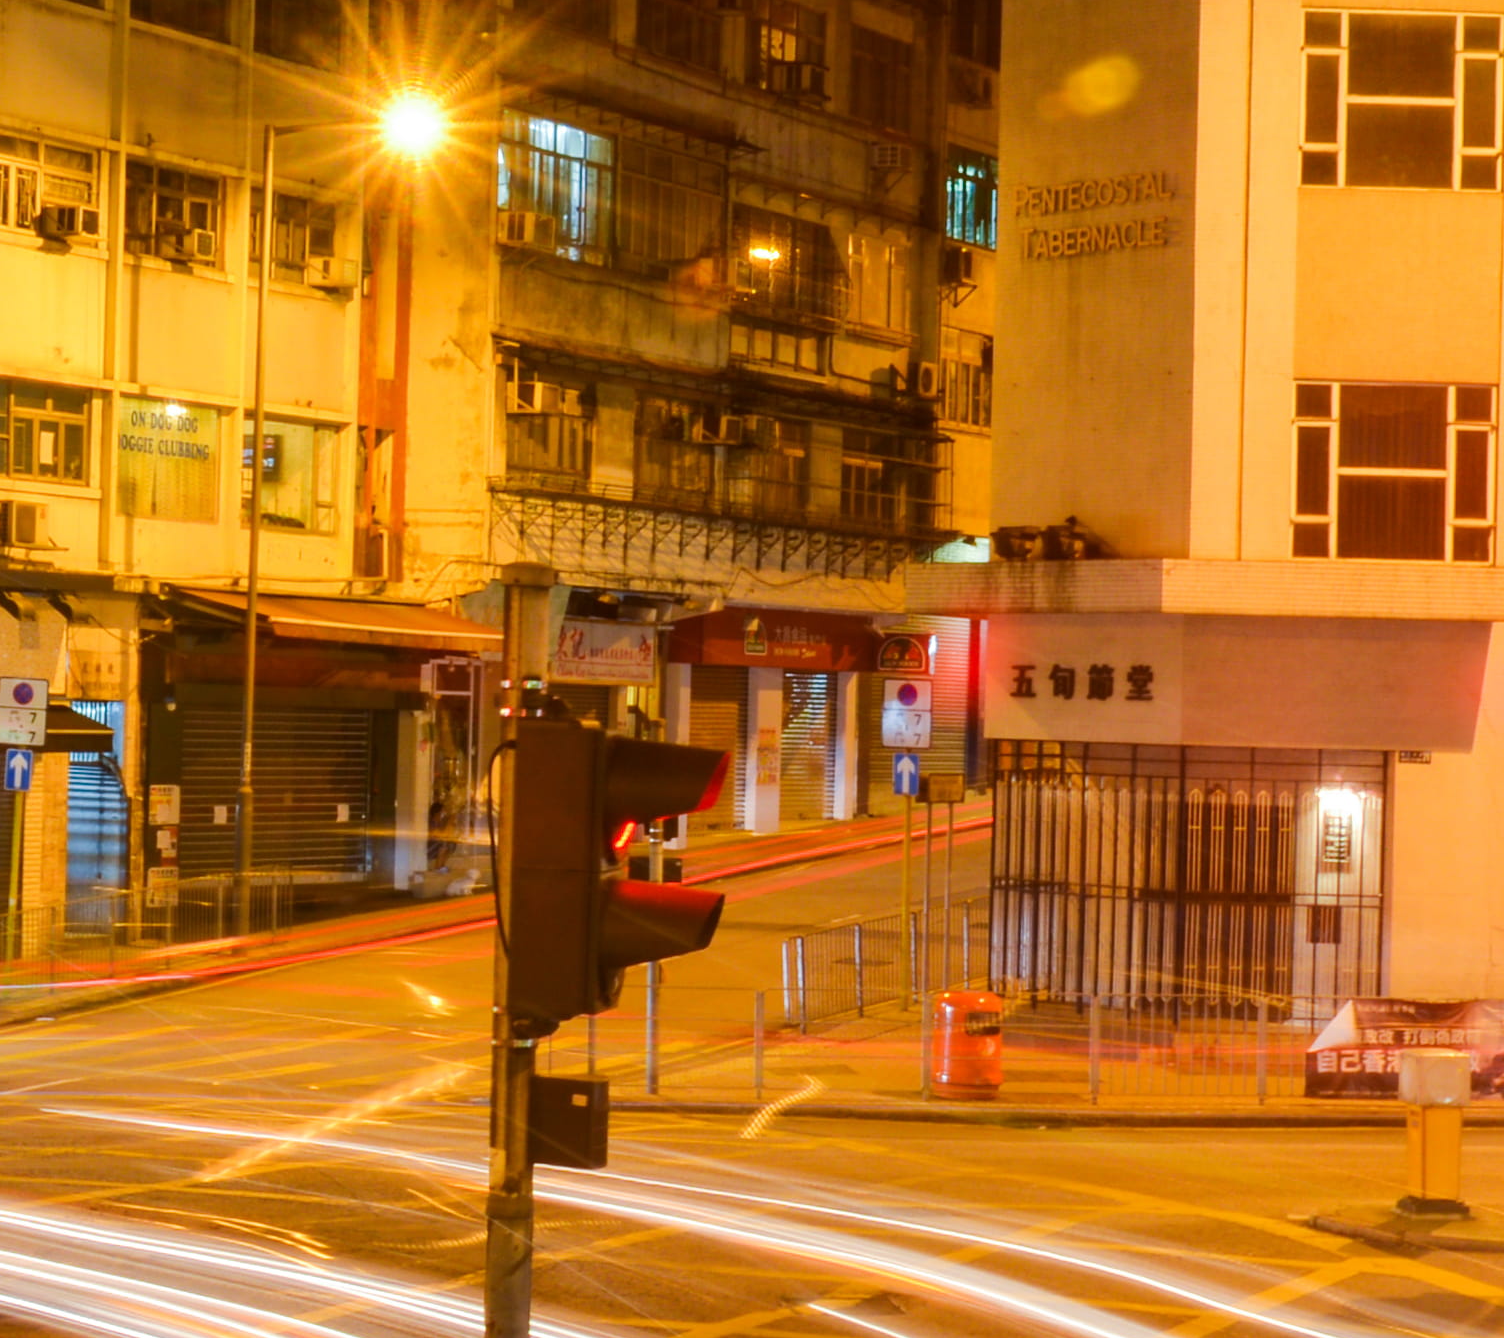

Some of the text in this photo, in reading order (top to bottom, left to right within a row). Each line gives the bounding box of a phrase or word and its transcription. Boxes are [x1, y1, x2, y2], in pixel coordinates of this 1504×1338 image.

[1015, 171, 1174, 218] PENTECOSTAL
[1021, 216, 1168, 259] TABERNACLE
[177, 416, 199, 433] DOG
[119, 434, 210, 460] OGGIE CLUBBING
